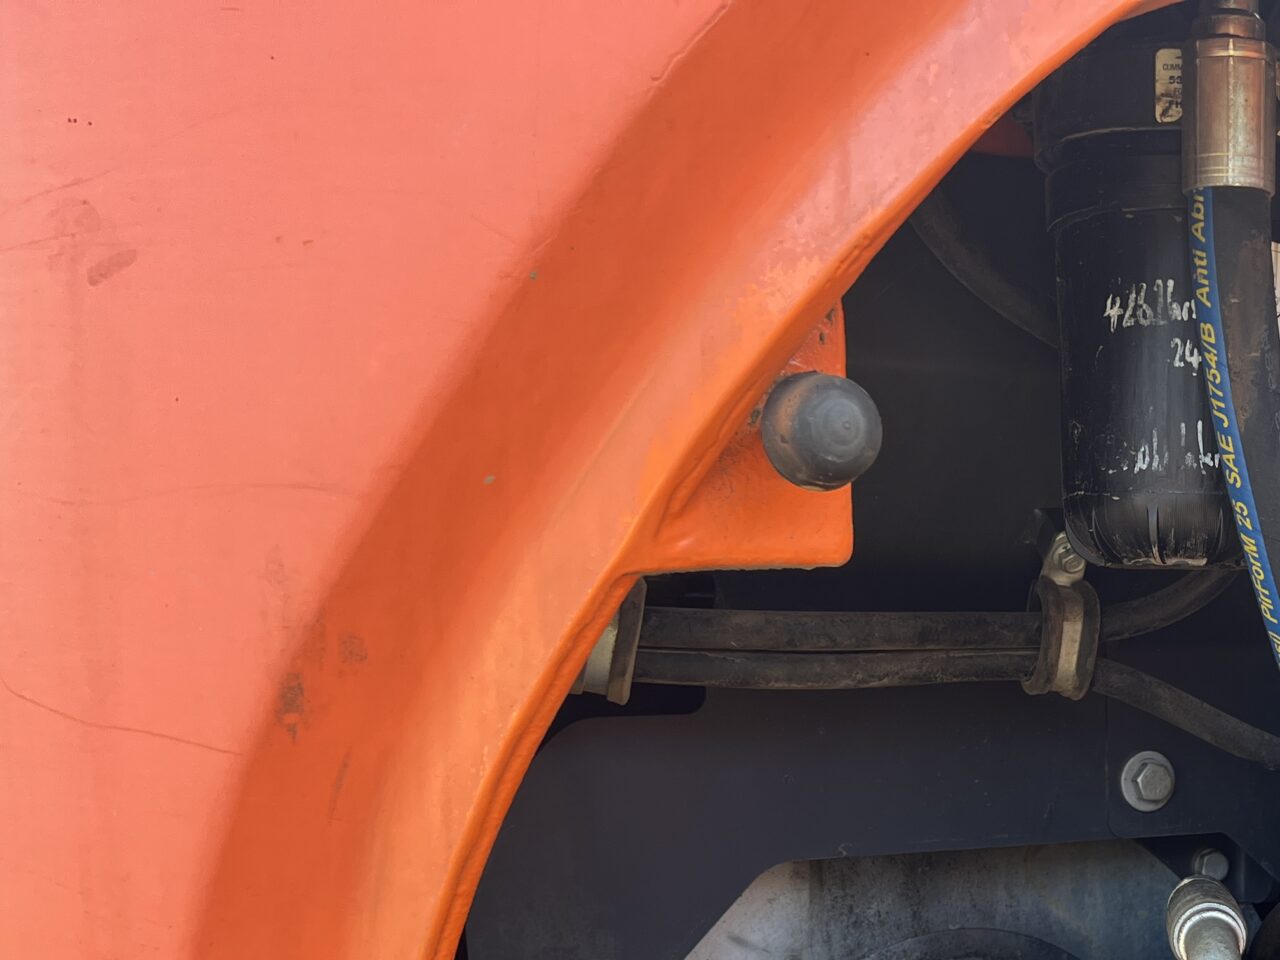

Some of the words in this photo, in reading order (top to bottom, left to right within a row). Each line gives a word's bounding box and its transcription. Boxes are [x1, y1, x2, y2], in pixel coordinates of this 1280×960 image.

[1191, 187, 1206, 243] Abr
[1191, 248, 1212, 308] Anti
[1200, 321, 1230, 429] J1754/B
[1217, 434, 1242, 489] SAE
[1230, 499, 1251, 531] 25
